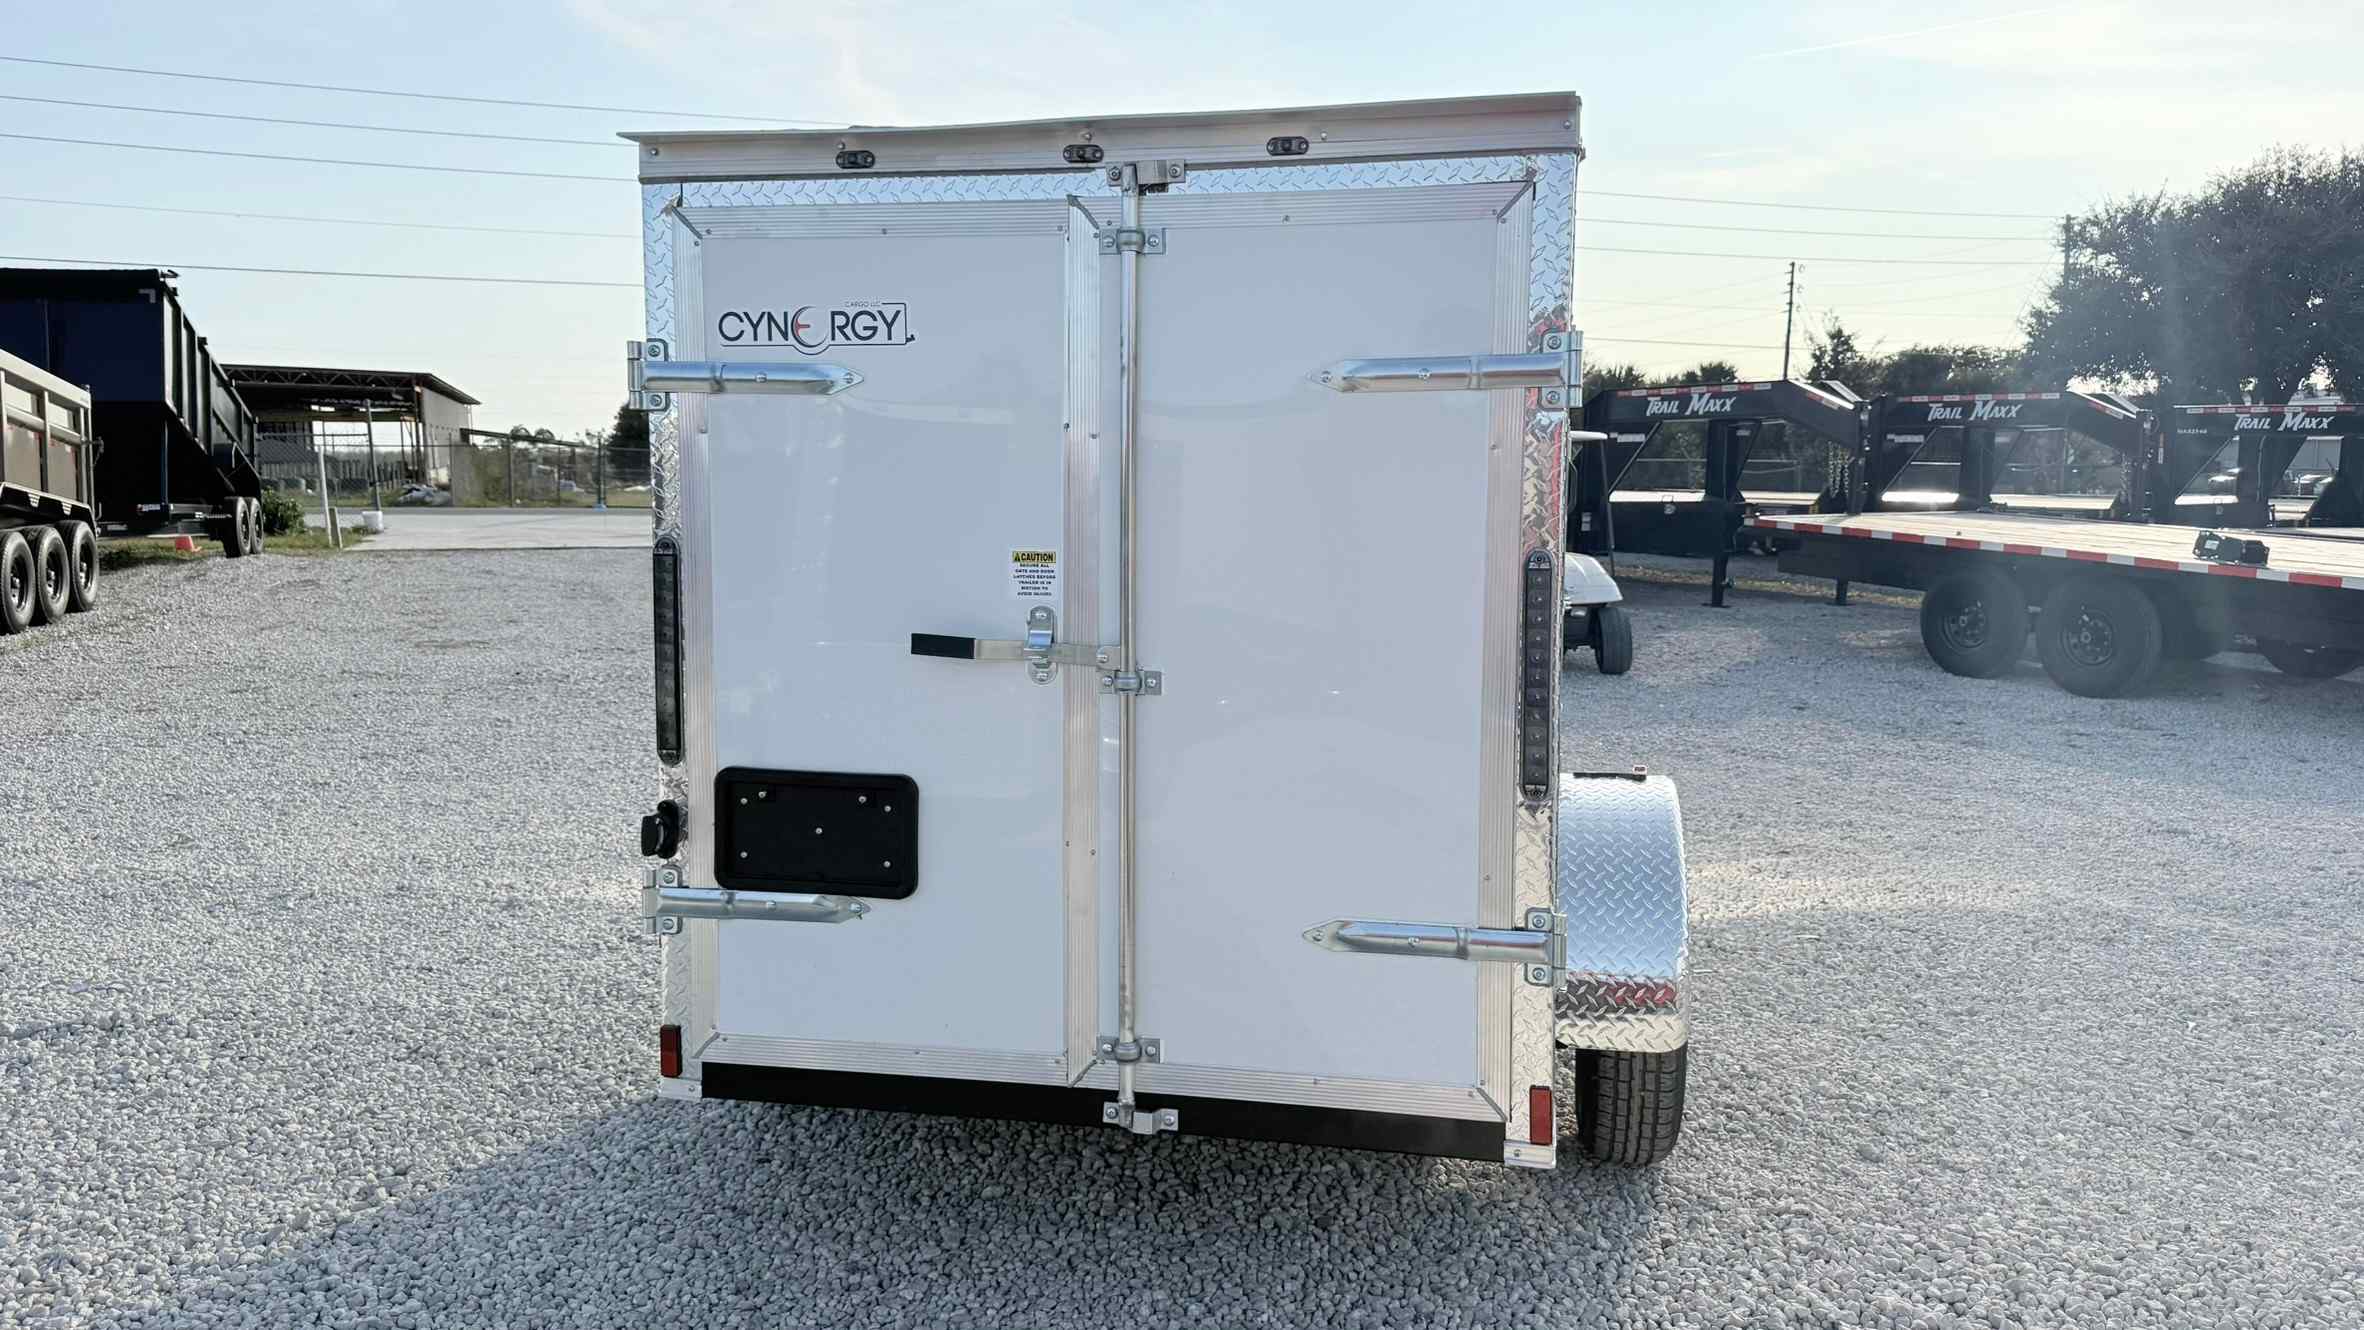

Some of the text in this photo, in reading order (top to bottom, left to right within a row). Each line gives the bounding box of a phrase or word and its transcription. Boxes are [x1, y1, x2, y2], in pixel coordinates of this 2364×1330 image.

[718, 306, 902, 347] CYNERGY
[1646, 393, 1736, 416] TRAIL MAXX
[1928, 400, 2023, 421] TRAIL MAXX
[2233, 412, 2334, 431] TRAIL MAXX
[1021, 552, 1054, 562] CAUTION
